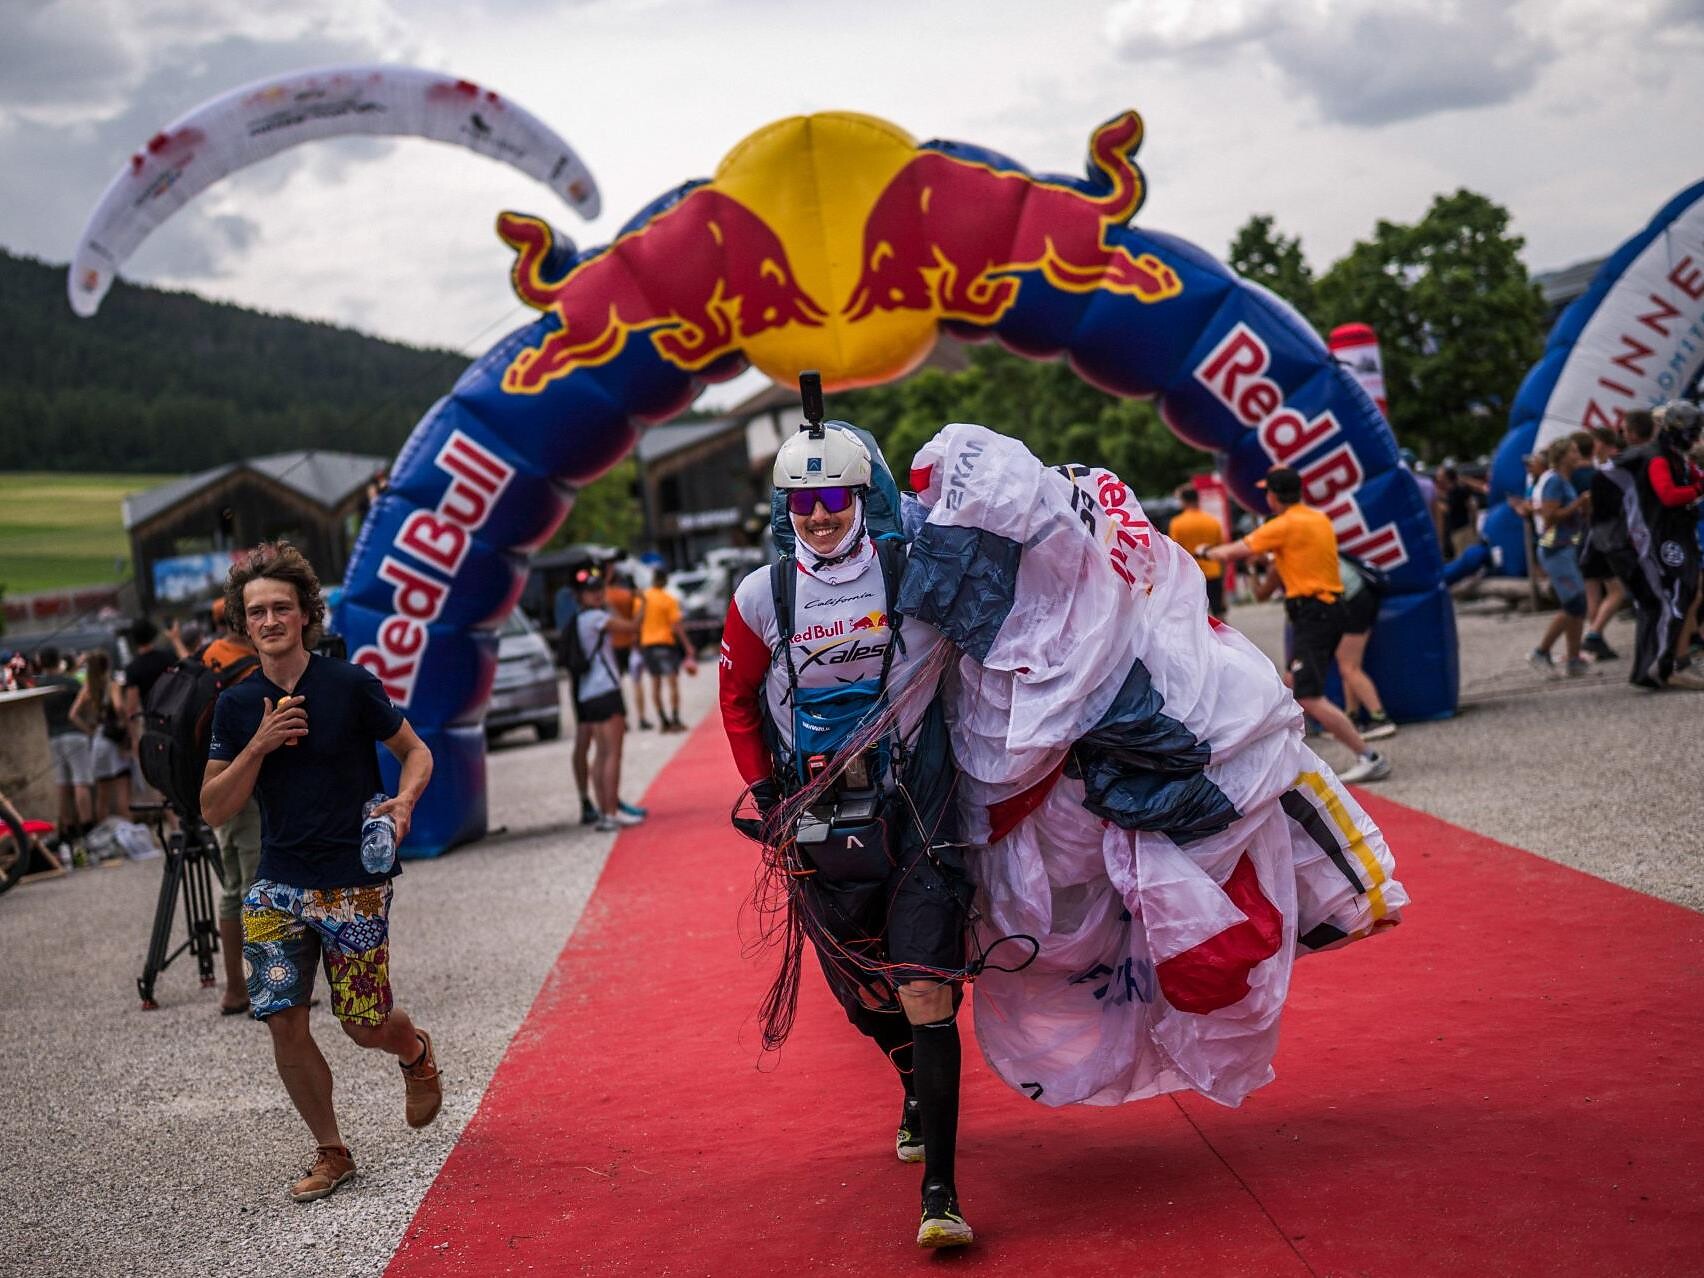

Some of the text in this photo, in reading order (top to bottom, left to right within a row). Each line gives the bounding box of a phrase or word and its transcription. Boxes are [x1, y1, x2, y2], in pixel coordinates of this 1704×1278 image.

[1193, 321, 1409, 572] Red Bull
[351, 428, 516, 708] Red Bull
[804, 589, 876, 609] California
[813, 620, 844, 640] Bull
